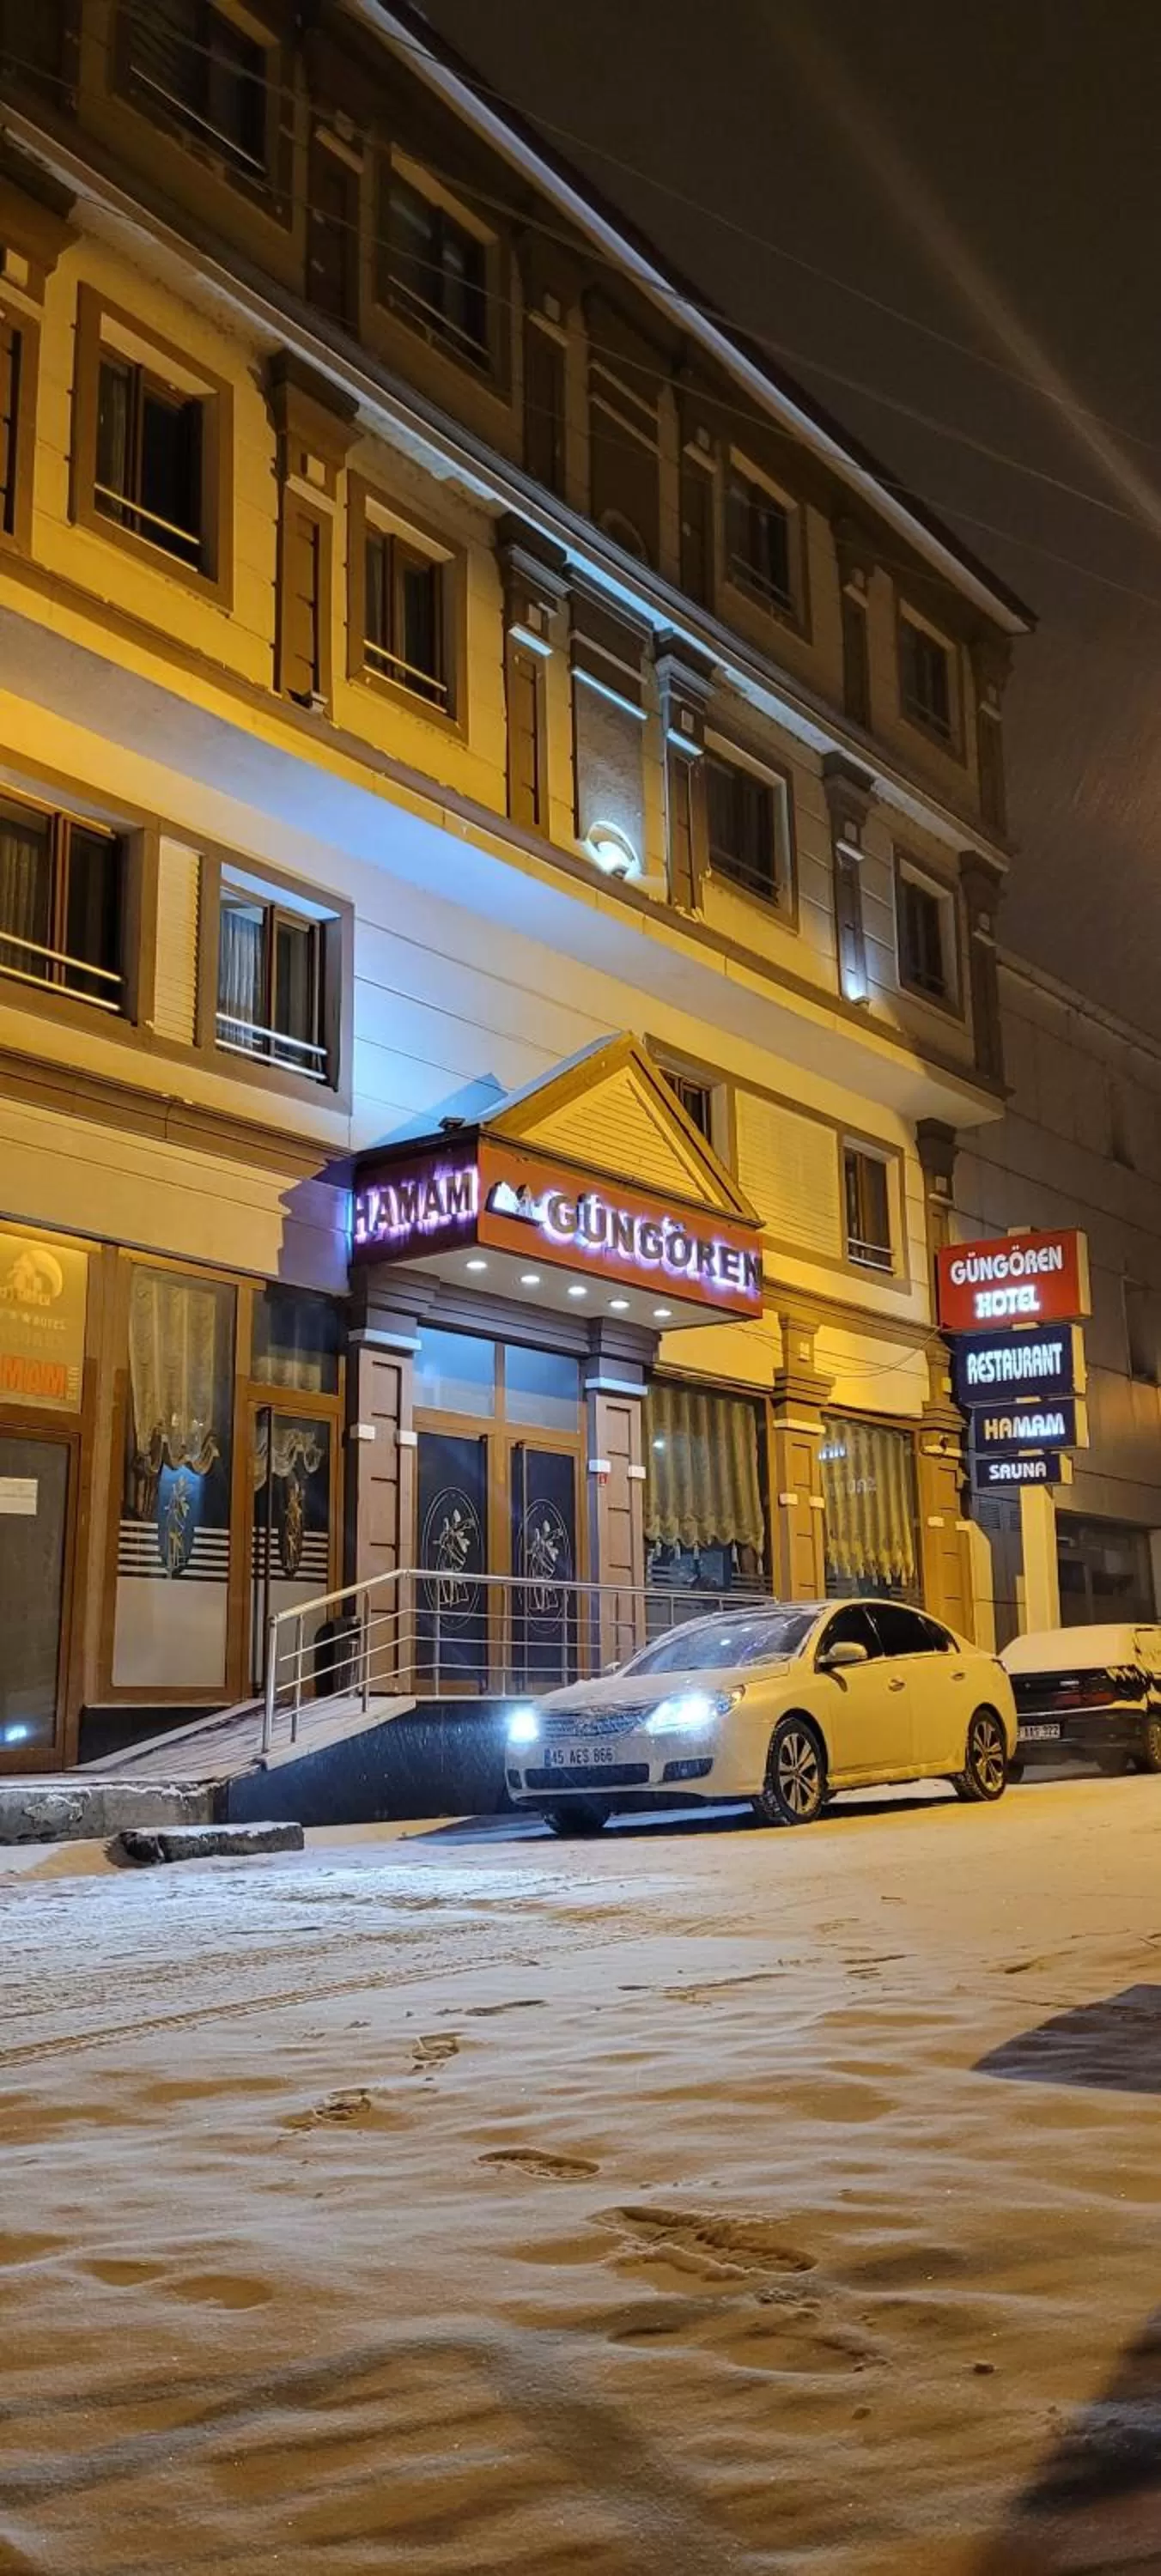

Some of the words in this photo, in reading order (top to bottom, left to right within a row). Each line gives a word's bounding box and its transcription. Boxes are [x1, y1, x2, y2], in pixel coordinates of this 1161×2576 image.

[354, 1170, 475, 1237] HAMAM
[547, 1191, 763, 1289] GÜNGÖREN
[951, 1245, 1063, 1285] GÜNGÖREN
[975, 1285, 1040, 1319] HOTEL
[967, 1343, 1063, 1384] RESTAURANT
[984, 1413, 1065, 1440] HAMAM
[989, 1461, 1047, 1480] SAUNA
